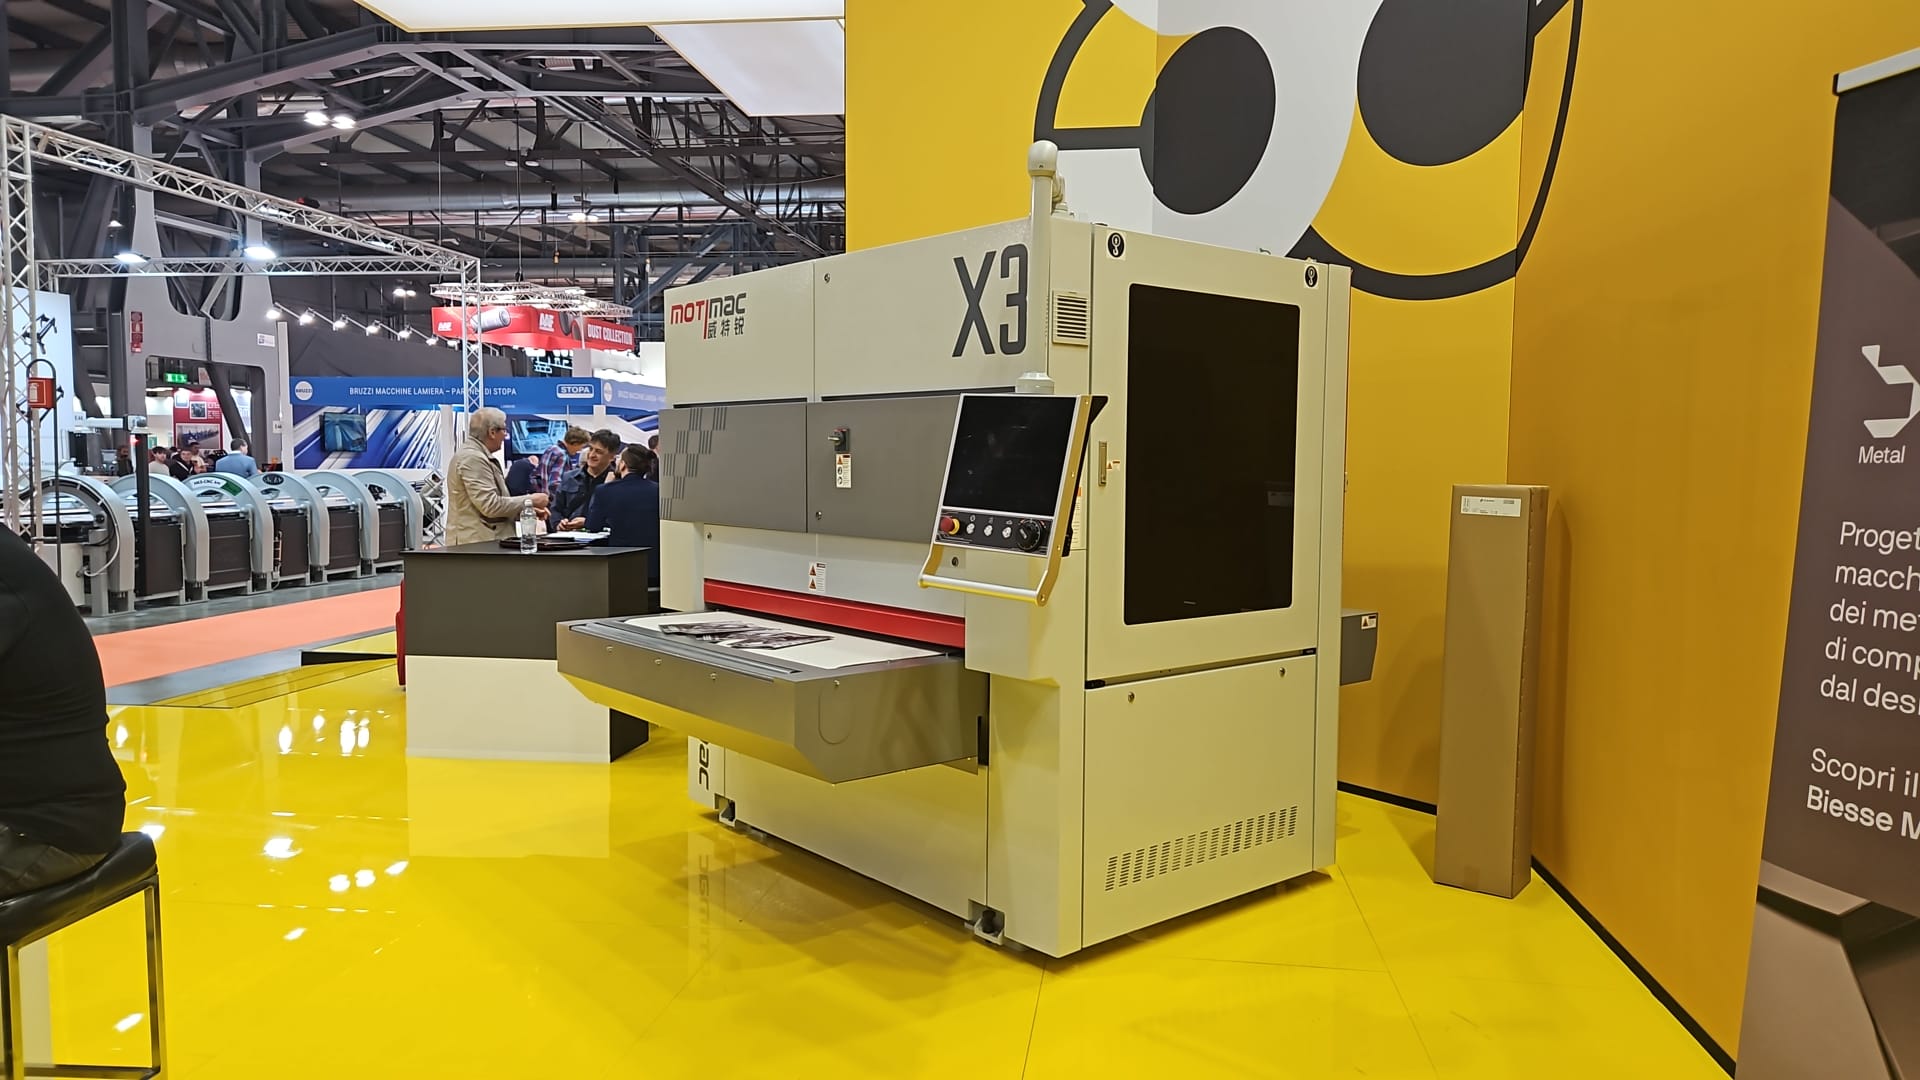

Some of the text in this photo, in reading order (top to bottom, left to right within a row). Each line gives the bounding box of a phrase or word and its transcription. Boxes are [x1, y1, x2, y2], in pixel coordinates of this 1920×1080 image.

[952, 243, 1029, 358] X3
[587, 323, 633, 346] DUST COLLECTION
[349, 387, 374, 396] BRUZZI
[375, 387, 413, 396] MACCHINE
[413, 387, 444, 396] LAMIERA
[451, 387, 484, 396] PARNE
[485, 387, 492, 396] DI
[493, 387, 517, 396] STOPA
[560, 386, 590, 394] STOPA
[1858, 445, 1906, 464] Metal
[1829, 598, 1920, 632] dei me
[1825, 636, 1848, 661] di
[1820, 674, 1857, 703] dal
[1811, 747, 1919, 798] Scopri il
[1807, 784, 1893, 832] Biesse
